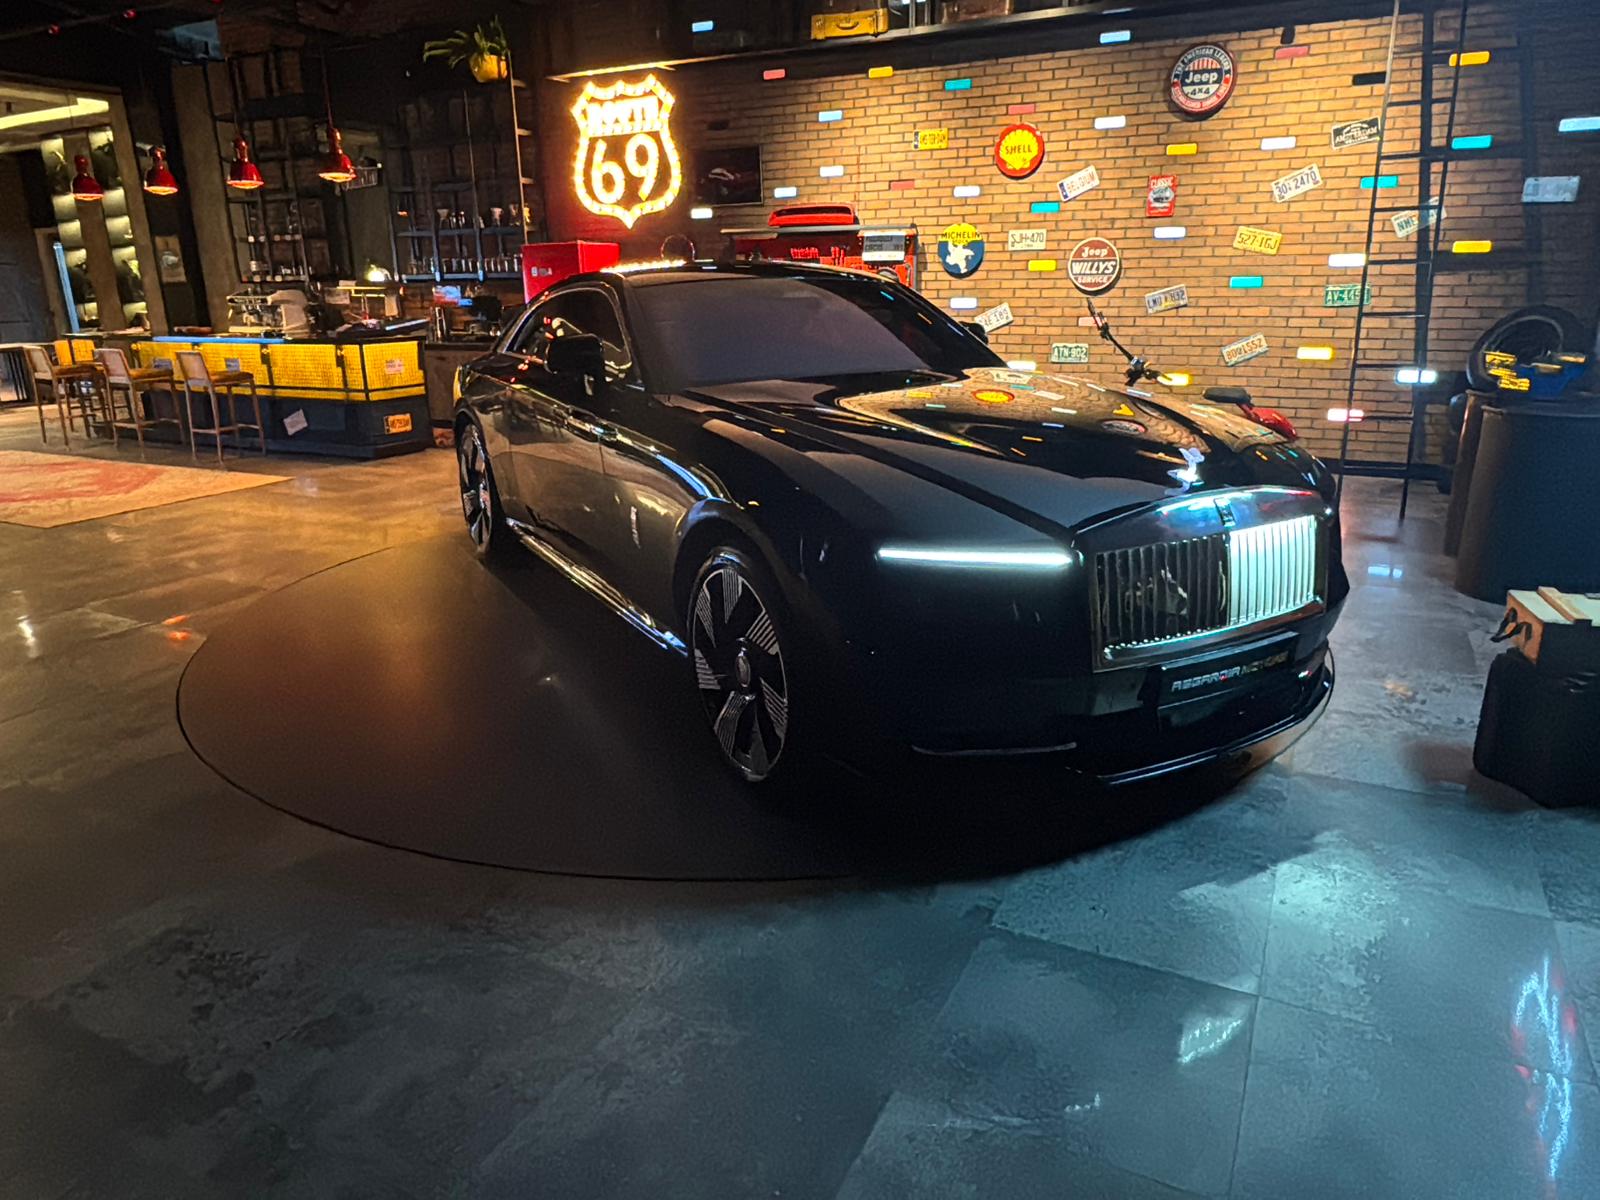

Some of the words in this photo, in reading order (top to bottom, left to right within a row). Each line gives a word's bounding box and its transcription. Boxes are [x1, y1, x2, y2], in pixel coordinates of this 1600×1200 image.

[1185, 71, 1218, 84] Jeep
[1005, 144, 1032, 154] SHELL
[592, 133, 660, 204] 69
[941, 231, 980, 240] MICHELIN
[1081, 246, 1108, 258] Jeep
[1071, 261, 1117, 274] WILLYS
